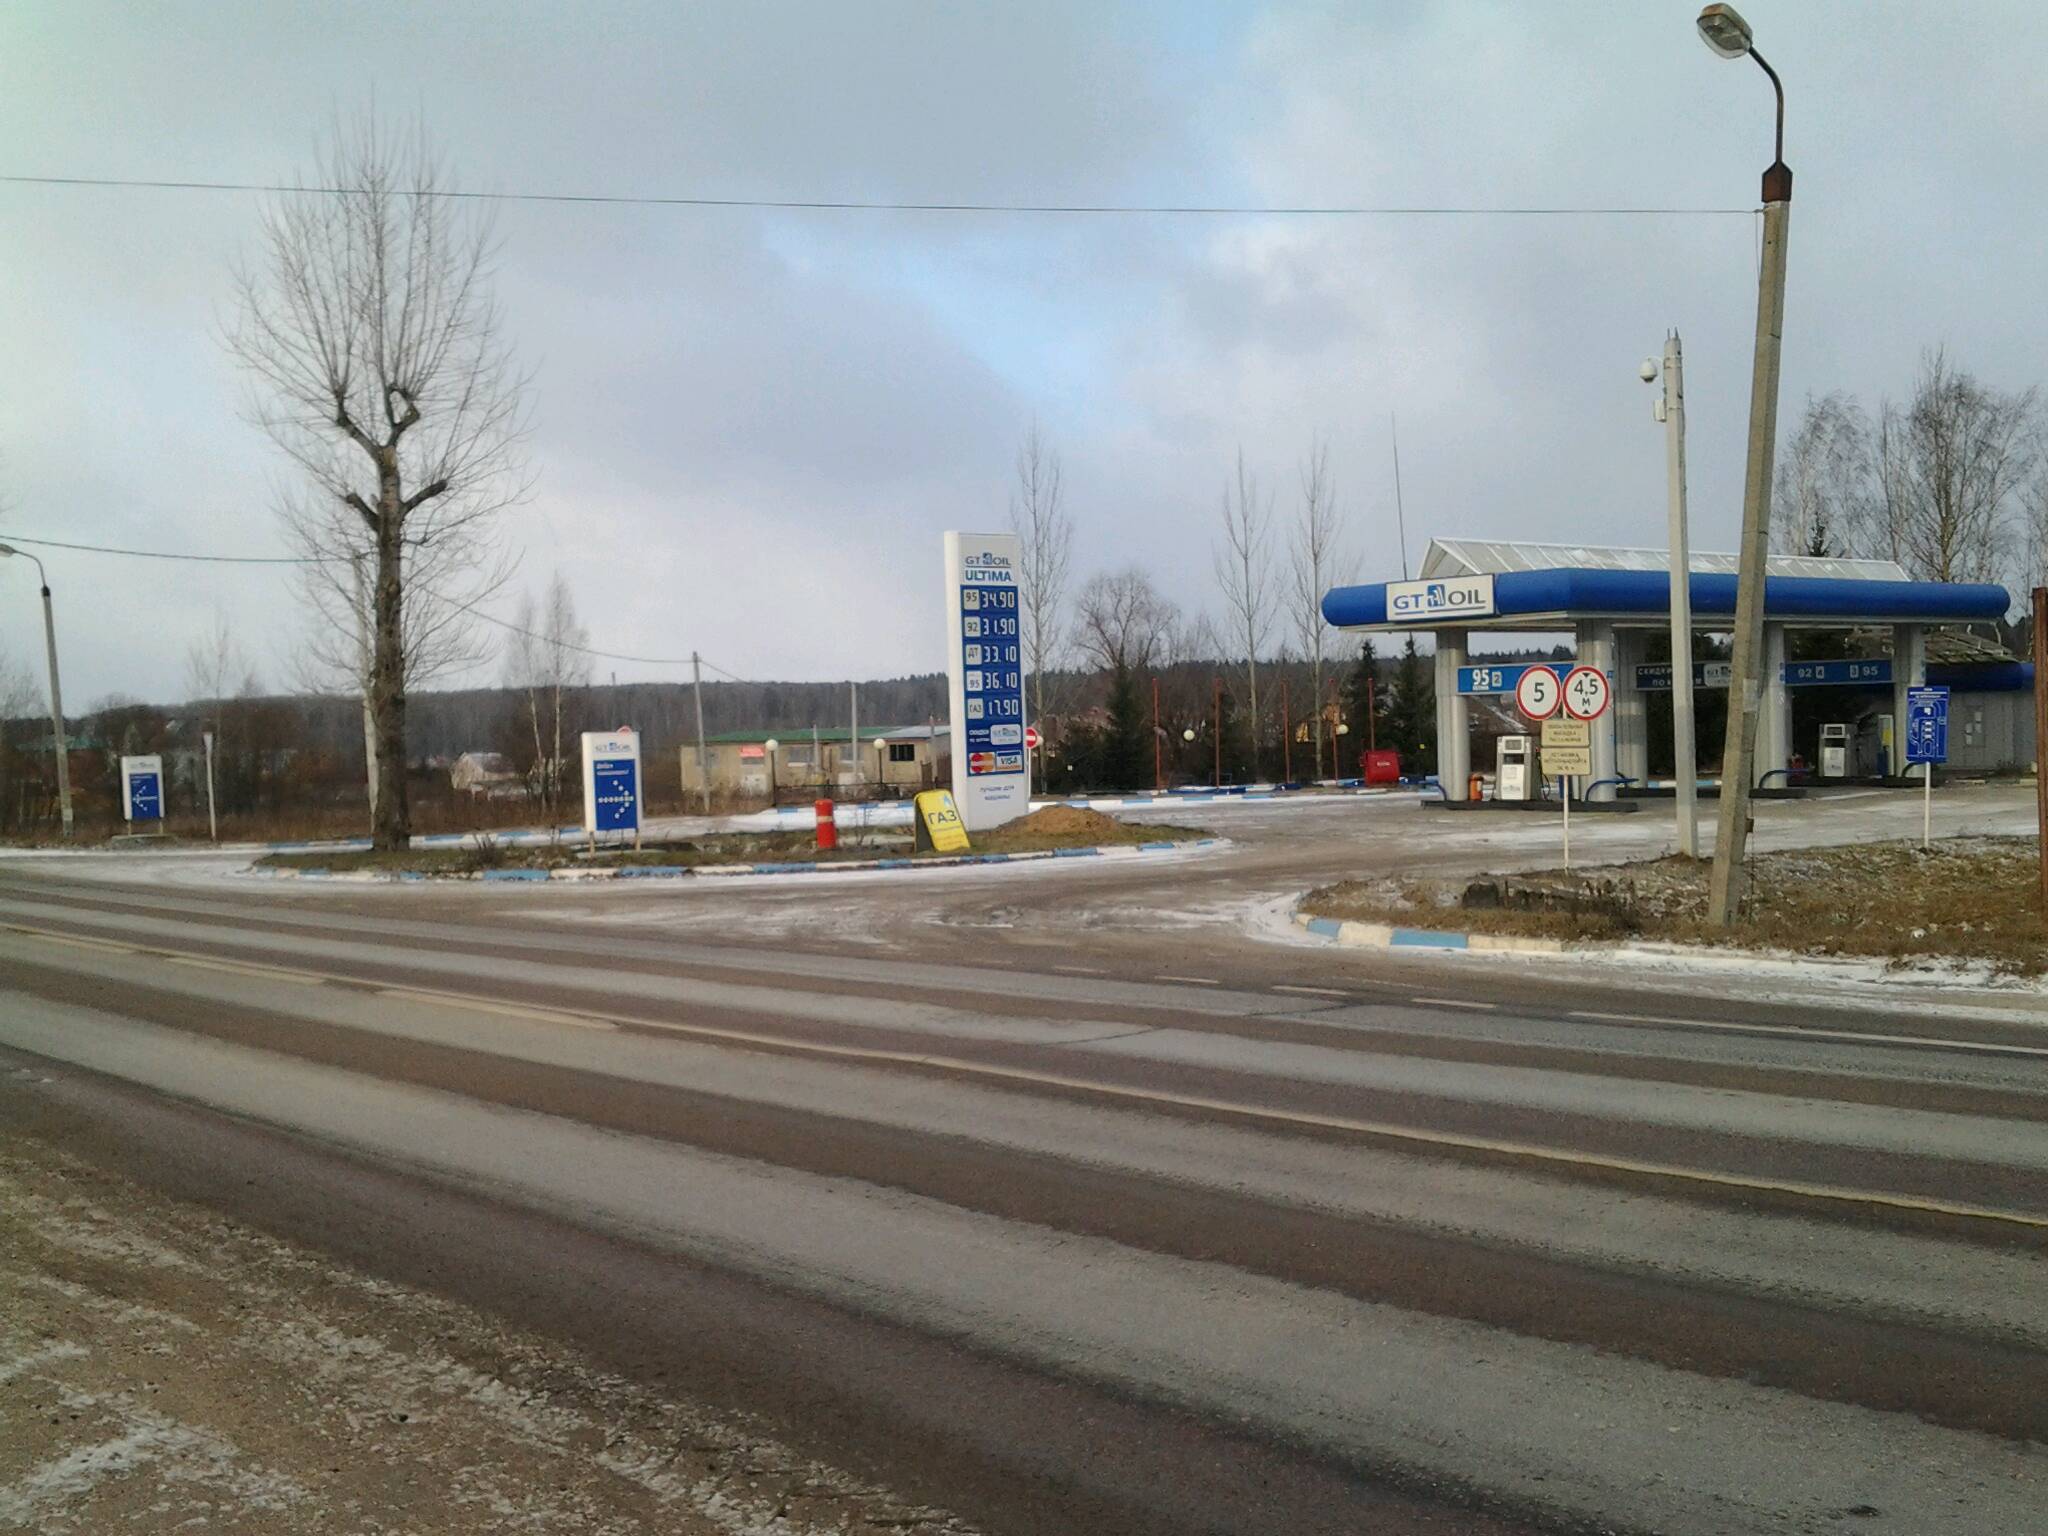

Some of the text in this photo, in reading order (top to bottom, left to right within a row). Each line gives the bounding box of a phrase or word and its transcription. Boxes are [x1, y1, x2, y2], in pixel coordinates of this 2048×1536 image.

[965, 556, 1011, 565] GT OIL
[965, 570, 1012, 582] ULTIMA
[965, 592, 978, 602] 95
[1393, 589, 1486, 610] GT OIL
[967, 618, 1016, 635] 92 31.90
[983, 646, 1017, 662] 33.10
[1472, 669, 1490, 686] 95
[1798, 668, 1812, 678] 92
[1863, 666, 1878, 676] 95
[970, 672, 1018, 689] 95 36.10
[1533, 682, 1545, 702] 5
[969, 704, 982, 713] ГАЗ
[1000, 756, 1018, 765] VISA
[928, 809, 957, 824] ГАЗ
